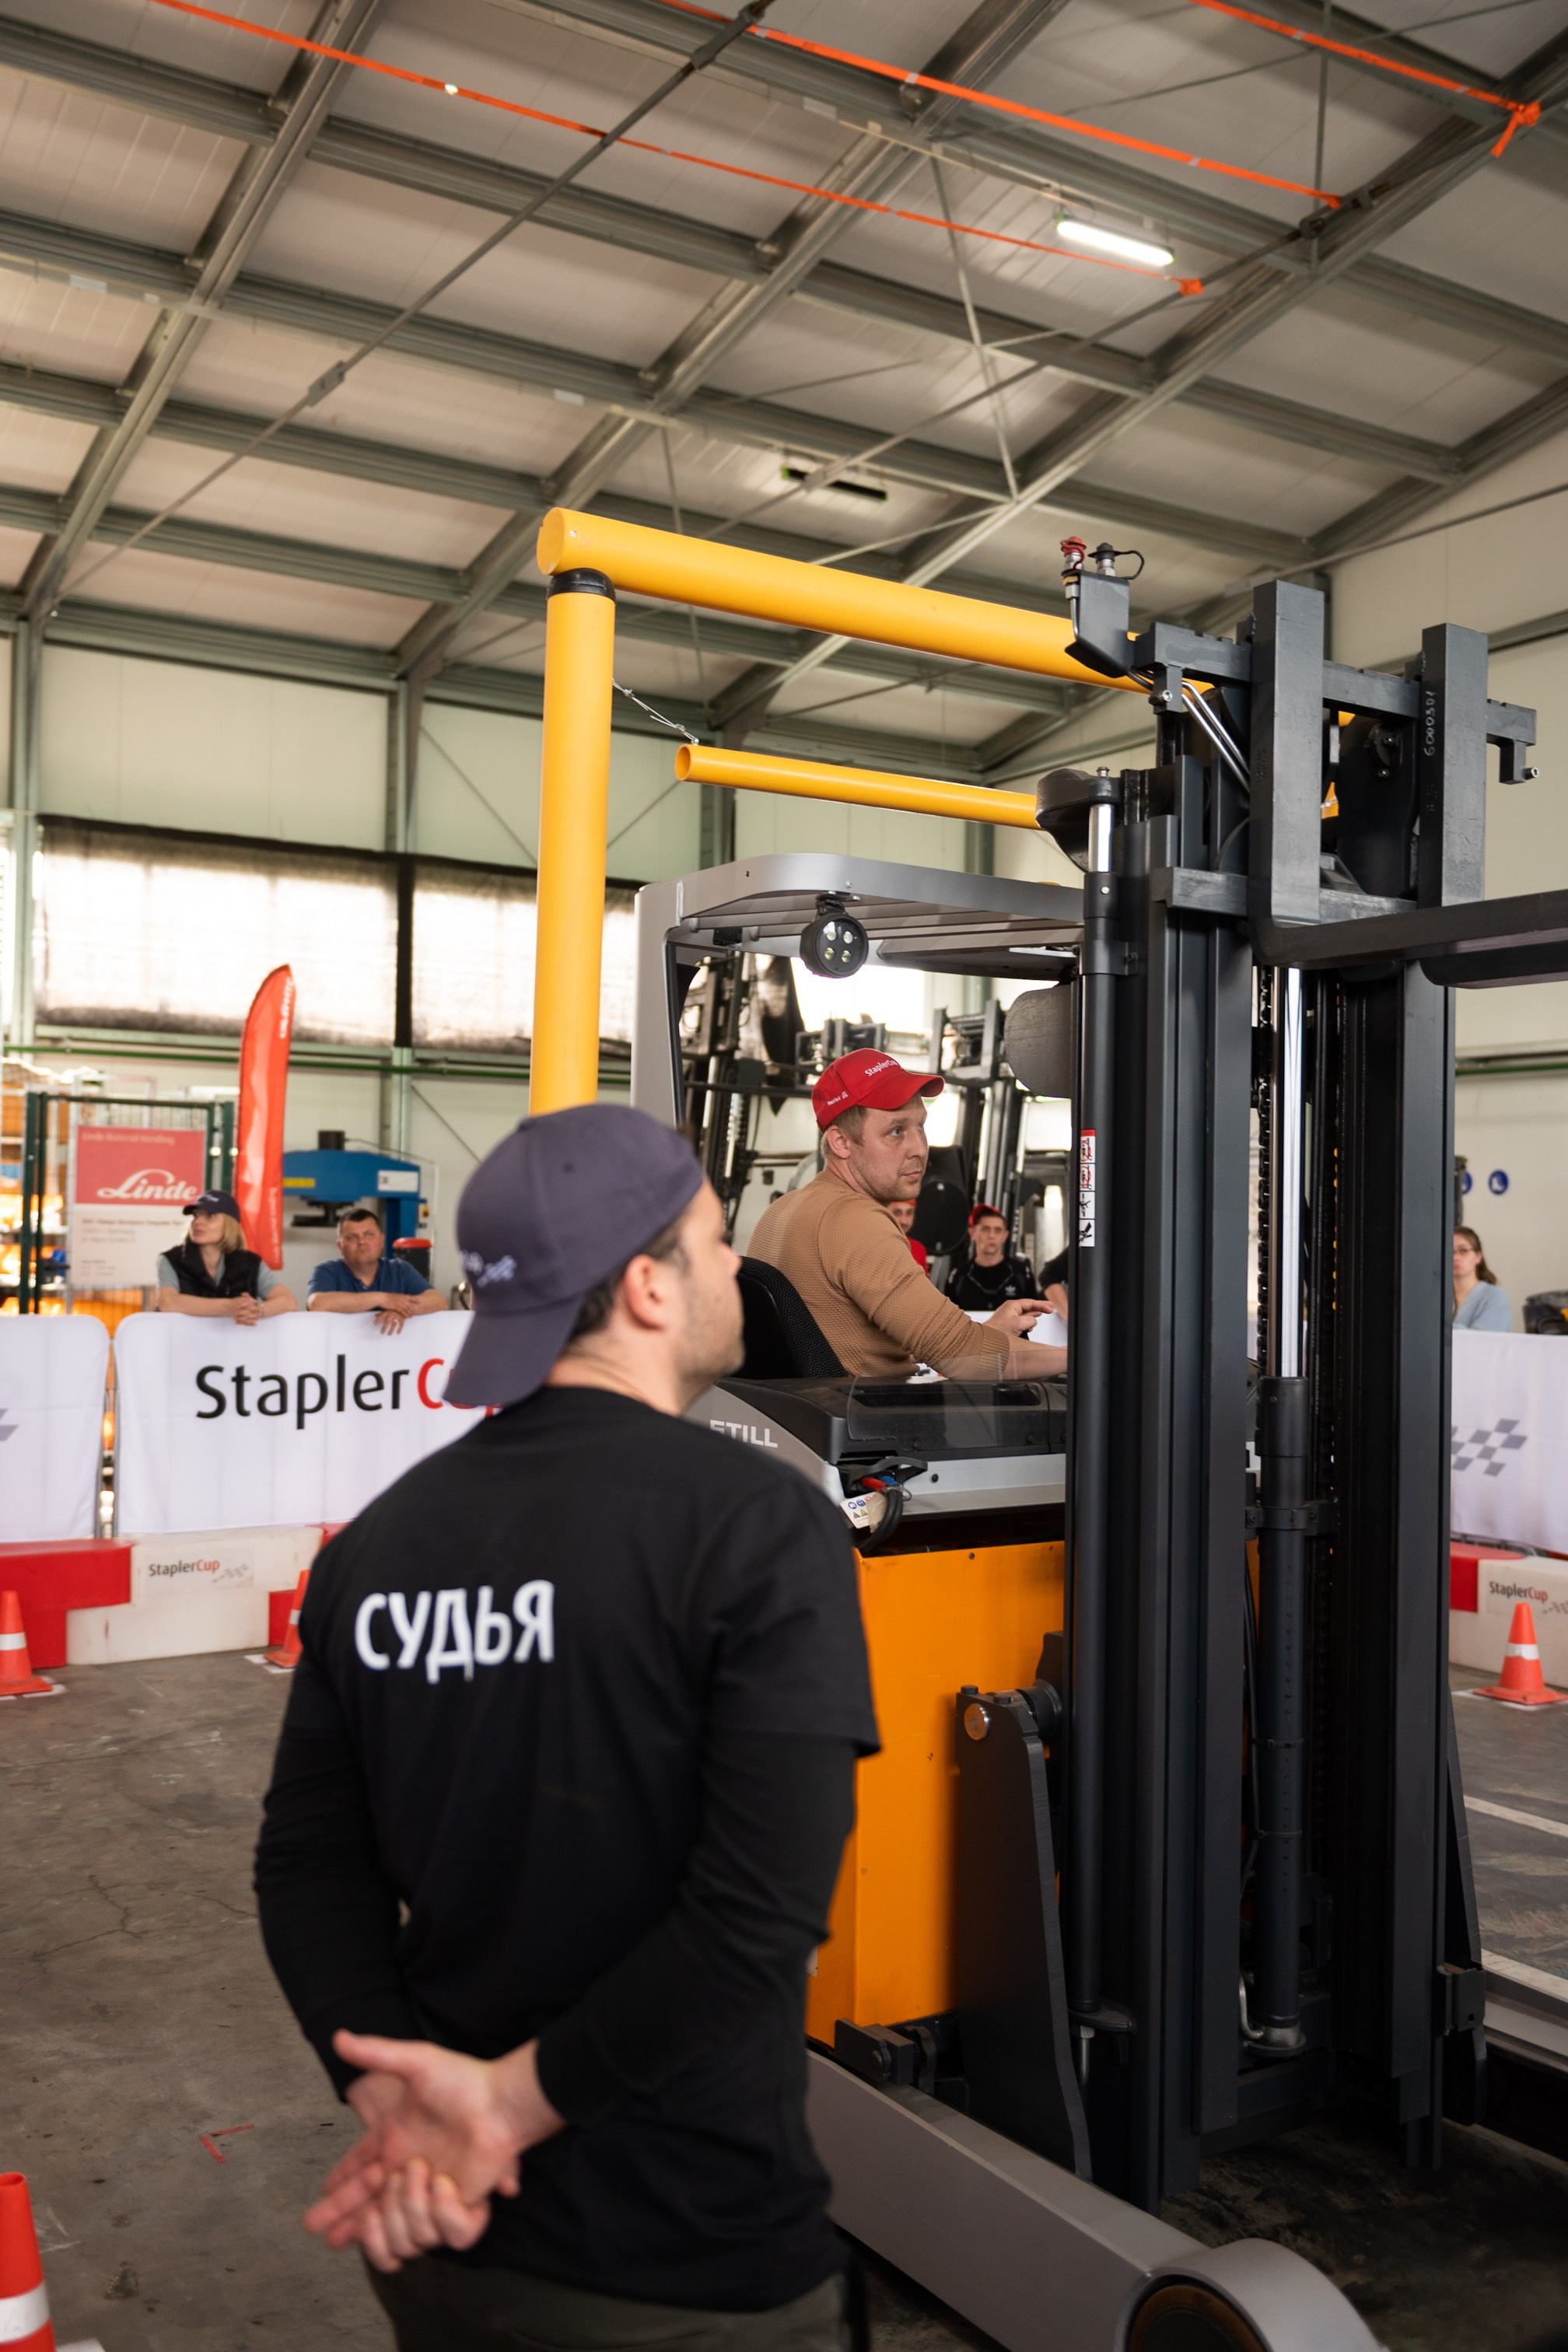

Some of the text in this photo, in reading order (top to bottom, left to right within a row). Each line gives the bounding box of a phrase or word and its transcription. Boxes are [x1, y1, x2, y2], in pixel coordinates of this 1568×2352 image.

[97, 1168, 198, 1201] Linde
[196, 1354, 502, 1430] StaplerC
[149, 1559, 221, 1578] StaplerCup
[1489, 1580, 1549, 1604] StaplerCup
[355, 1579, 555, 1685] СУДЬЯ
